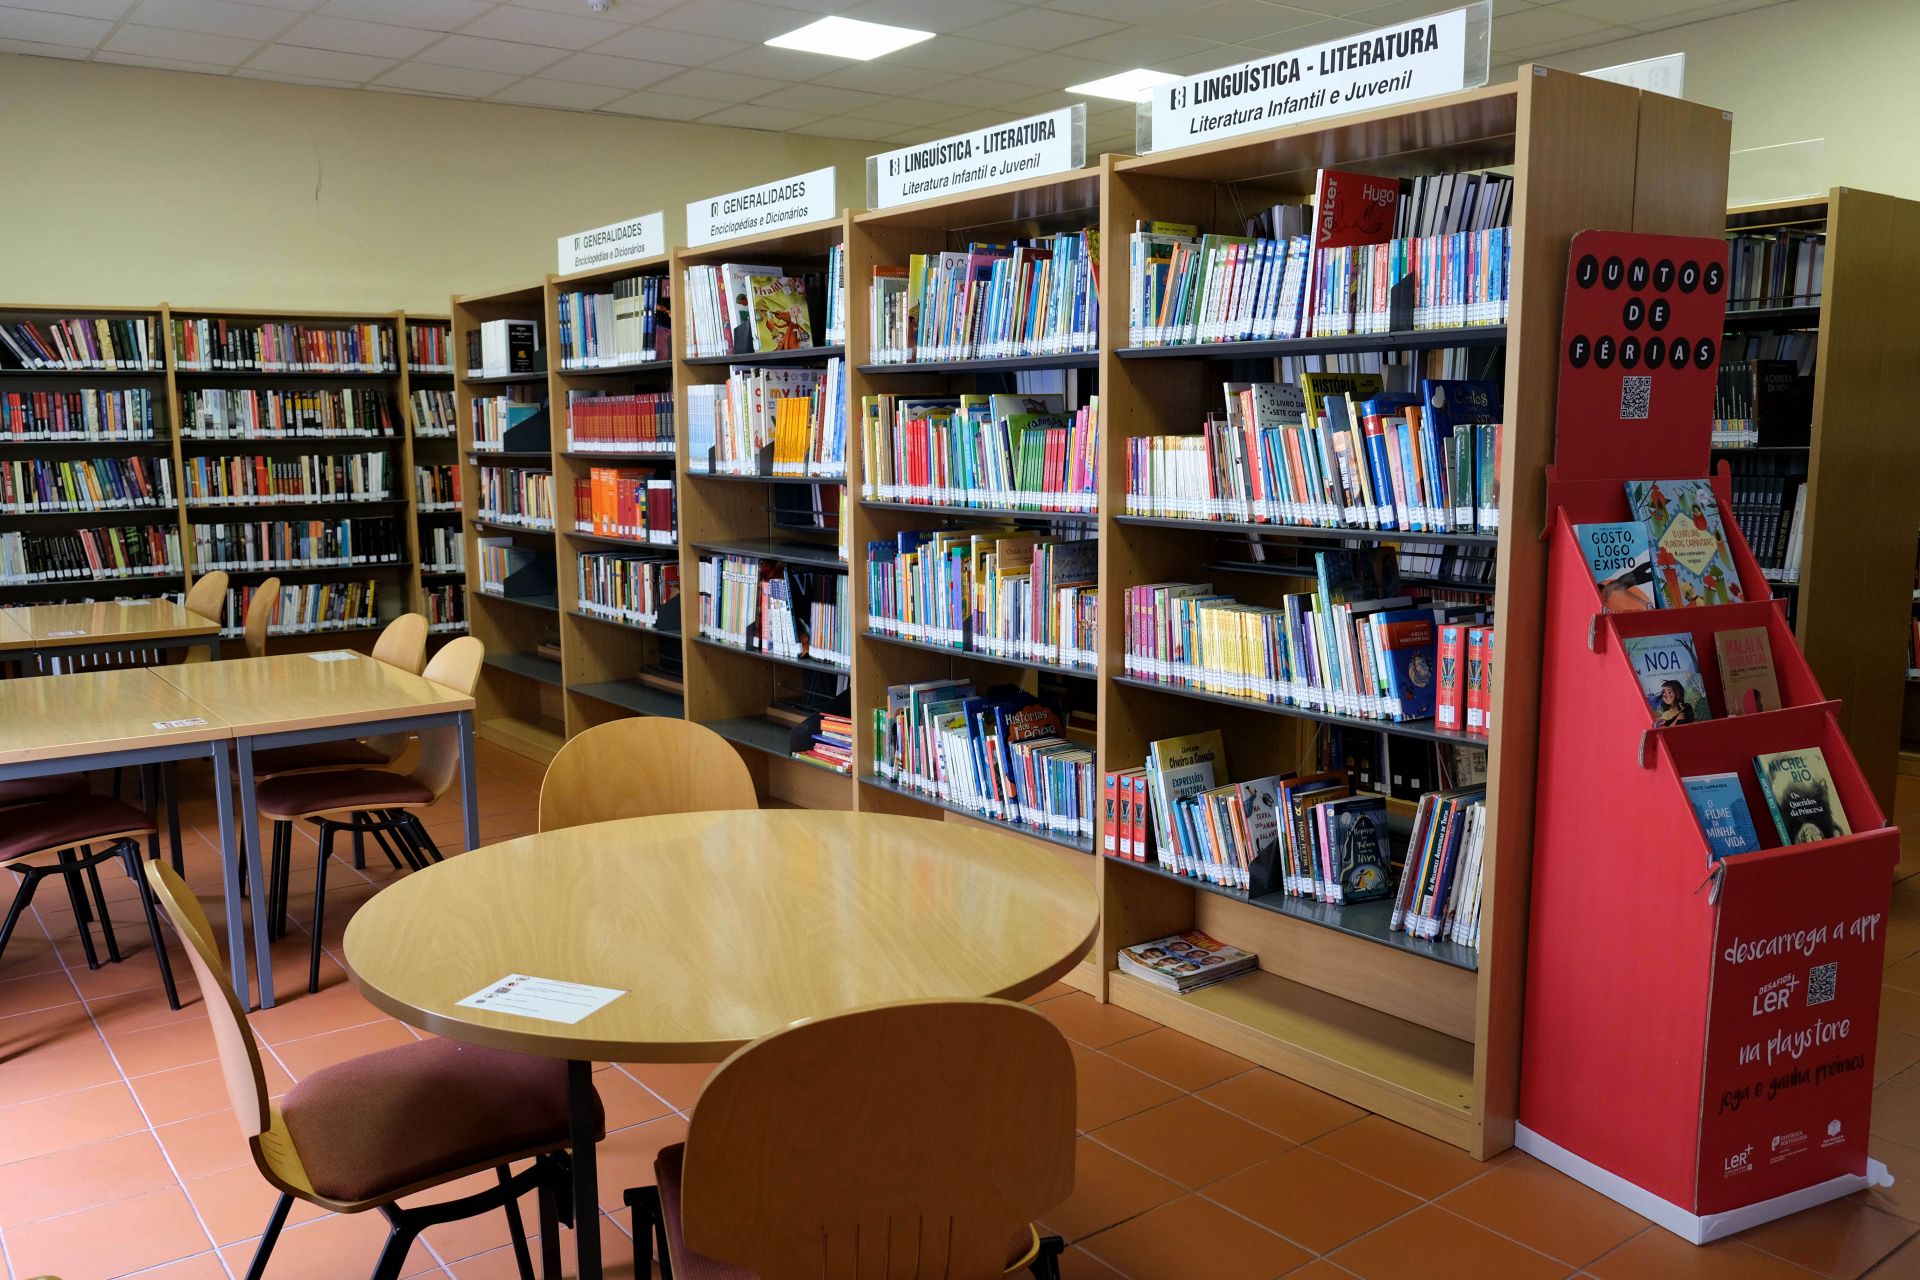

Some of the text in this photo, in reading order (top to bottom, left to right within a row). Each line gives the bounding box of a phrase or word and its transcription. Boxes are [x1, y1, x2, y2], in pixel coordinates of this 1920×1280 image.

[1193, 57, 1301, 106] LINGUÍSTICA
[1319, 23, 1439, 76] LITERATURA
[1189, 69, 1413, 135] Literatura Infantil e Juvenil
[904, 138, 972, 173] LINGUÍSTICA
[983, 118, 1056, 155] LITERATURA
[902, 152, 1041, 196] Literatura Infantil e Juvenil
[723, 181, 806, 215] GENERALIDADES
[1362, 183, 1395, 207] Hugo
[1320, 177, 1338, 243] Valter
[710, 206, 808, 237] Enciclopédias e Dicionários
[583, 222, 642, 249] GENERALIDADES
[574, 243, 645, 268] Enciclopédias e Dicionários
[1583, 264, 1717, 286] JUNTOS
[753, 279, 783, 296] Vivaldi
[1628, 305, 1663, 322] DE
[1575, 340, 1708, 361] FÉRIAS
[1311, 375, 1357, 393] HISTÓRIA
[1276, 399, 1295, 408] LIVRO
[1272, 408, 1287, 417] SETE
[1591, 530, 1634, 545] GOSTO,
[1597, 544, 1630, 558] LOGO
[1594, 557, 1636, 571] EXISTO
[1726, 637, 1764, 655] MALALA
[1644, 650, 1681, 672] NOA
[1004, 710, 1049, 726] Histórias
[1018, 723, 1030, 731] dos
[1169, 757, 1190, 769] Cheiro
[1768, 756, 1808, 773] MICHEL
[1172, 772, 1204, 789] EXPRESSÕES
[1791, 769, 1812, 784] RIO
[1707, 799, 1714, 808] O
[1789, 799, 1818, 810] Queridos
[1798, 806, 1824, 816] Princesa
[1255, 813, 1272, 821] TERRA
[1705, 807, 1731, 821] FILME
[1706, 826, 1737, 840] MINHA
[1725, 836, 1746, 848] VIDA
[1724, 912, 1881, 965] descarrega a app
[1758, 972, 1792, 996] DESAFIOS
[1738, 1018, 1850, 1067] na playstore
[1717, 1085, 1750, 1116] joga
[1754, 1081, 1764, 1097] e
[1768, 1065, 1811, 1101] ganha
